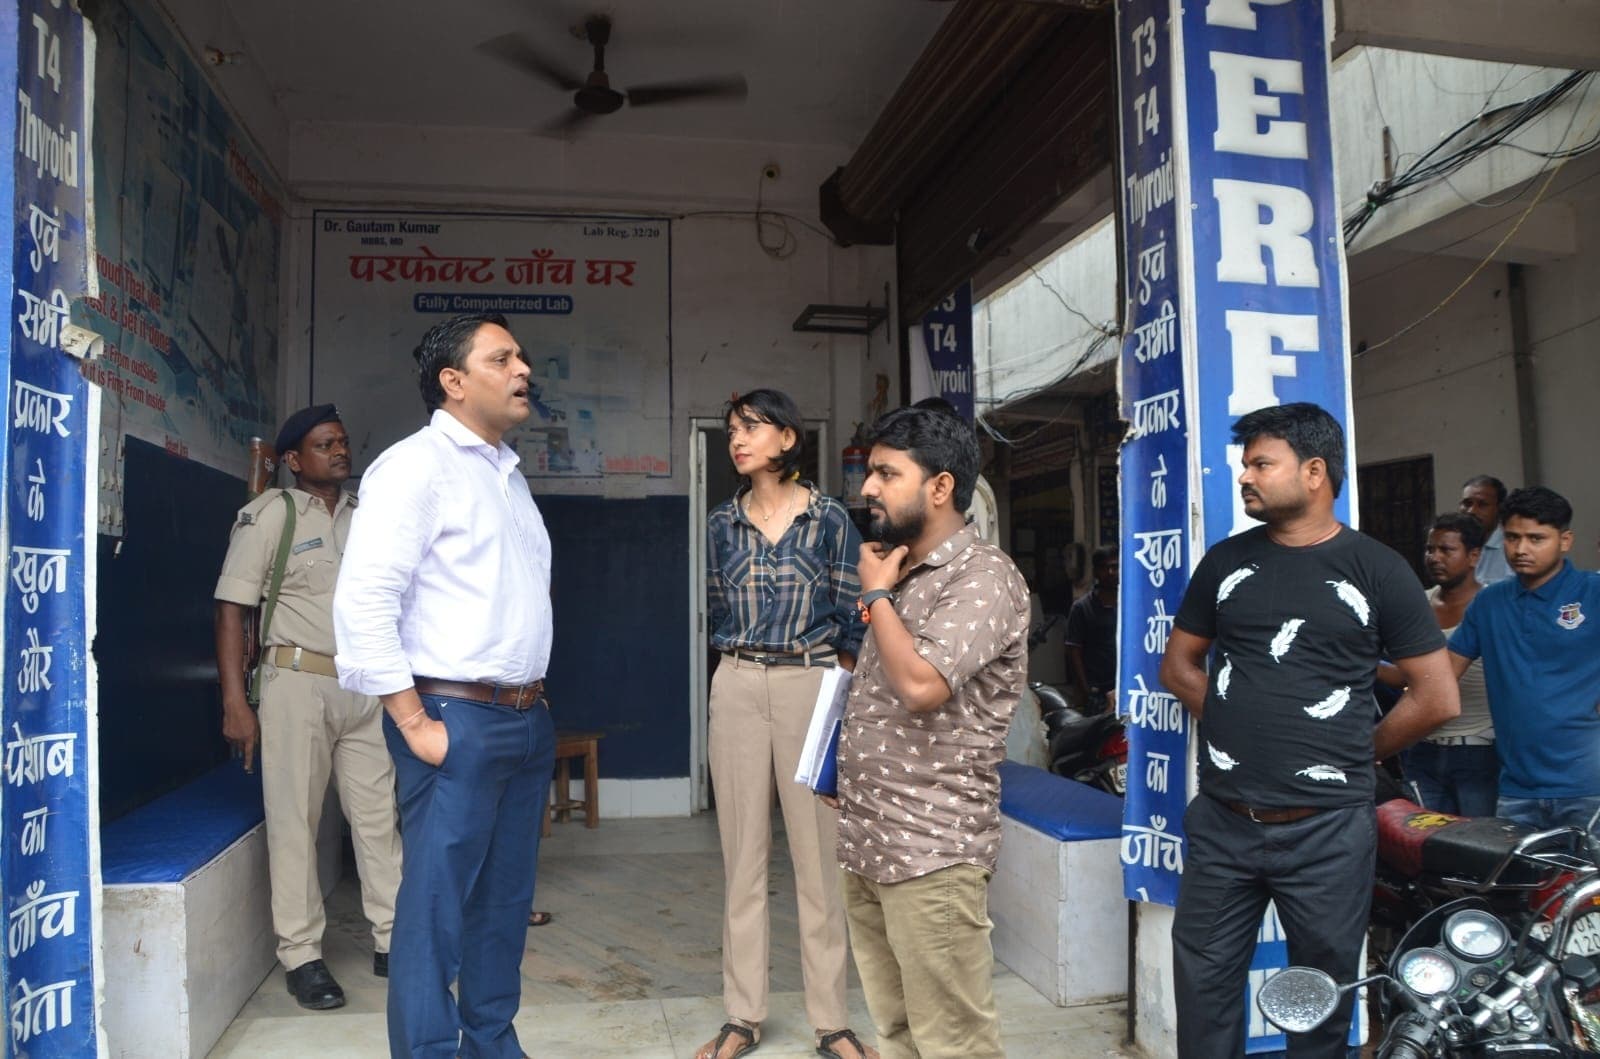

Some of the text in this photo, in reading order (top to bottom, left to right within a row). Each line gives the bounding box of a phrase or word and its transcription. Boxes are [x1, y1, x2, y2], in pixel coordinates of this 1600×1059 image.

[32, 13, 62, 92] T4
[1132, 16, 1158, 77] T3
[18, 88, 78, 188] Thyroid
[1134, 85, 1160, 146] T4
[1127, 147, 1175, 228] Thyroid
[29, 203, 61, 273] एवं
[324, 219, 441, 234] Dr. Gautam Kumar
[583, 226, 605, 237] Lab
[97, 253, 122, 288] roud
[348, 246, 637, 287] परफेक्ट जाँच घर
[1138, 229, 1167, 307] एवं
[110, 295, 118, 322] &
[121, 303, 138, 334] Get
[418, 296, 570, 311] Fully Computerized Lab
[1134, 300, 1176, 364] सभी
[930, 323, 957, 352] T4
[15, 380, 74, 438] प्रकार
[1133, 388, 1181, 440] प्रकार
[28, 458, 47, 522] के
[1151, 454, 1168, 510] के
[18, 627, 54, 694] और
[1128, 673, 1184, 735] पेशाब
[7, 721, 78, 788] पेशाब
[1146, 751, 1171, 795] का
[21, 806, 48, 857] का
[1120, 814, 1184, 875] जाँच
[9, 879, 80, 959] जाँच
[11, 978, 77, 1056] होता
